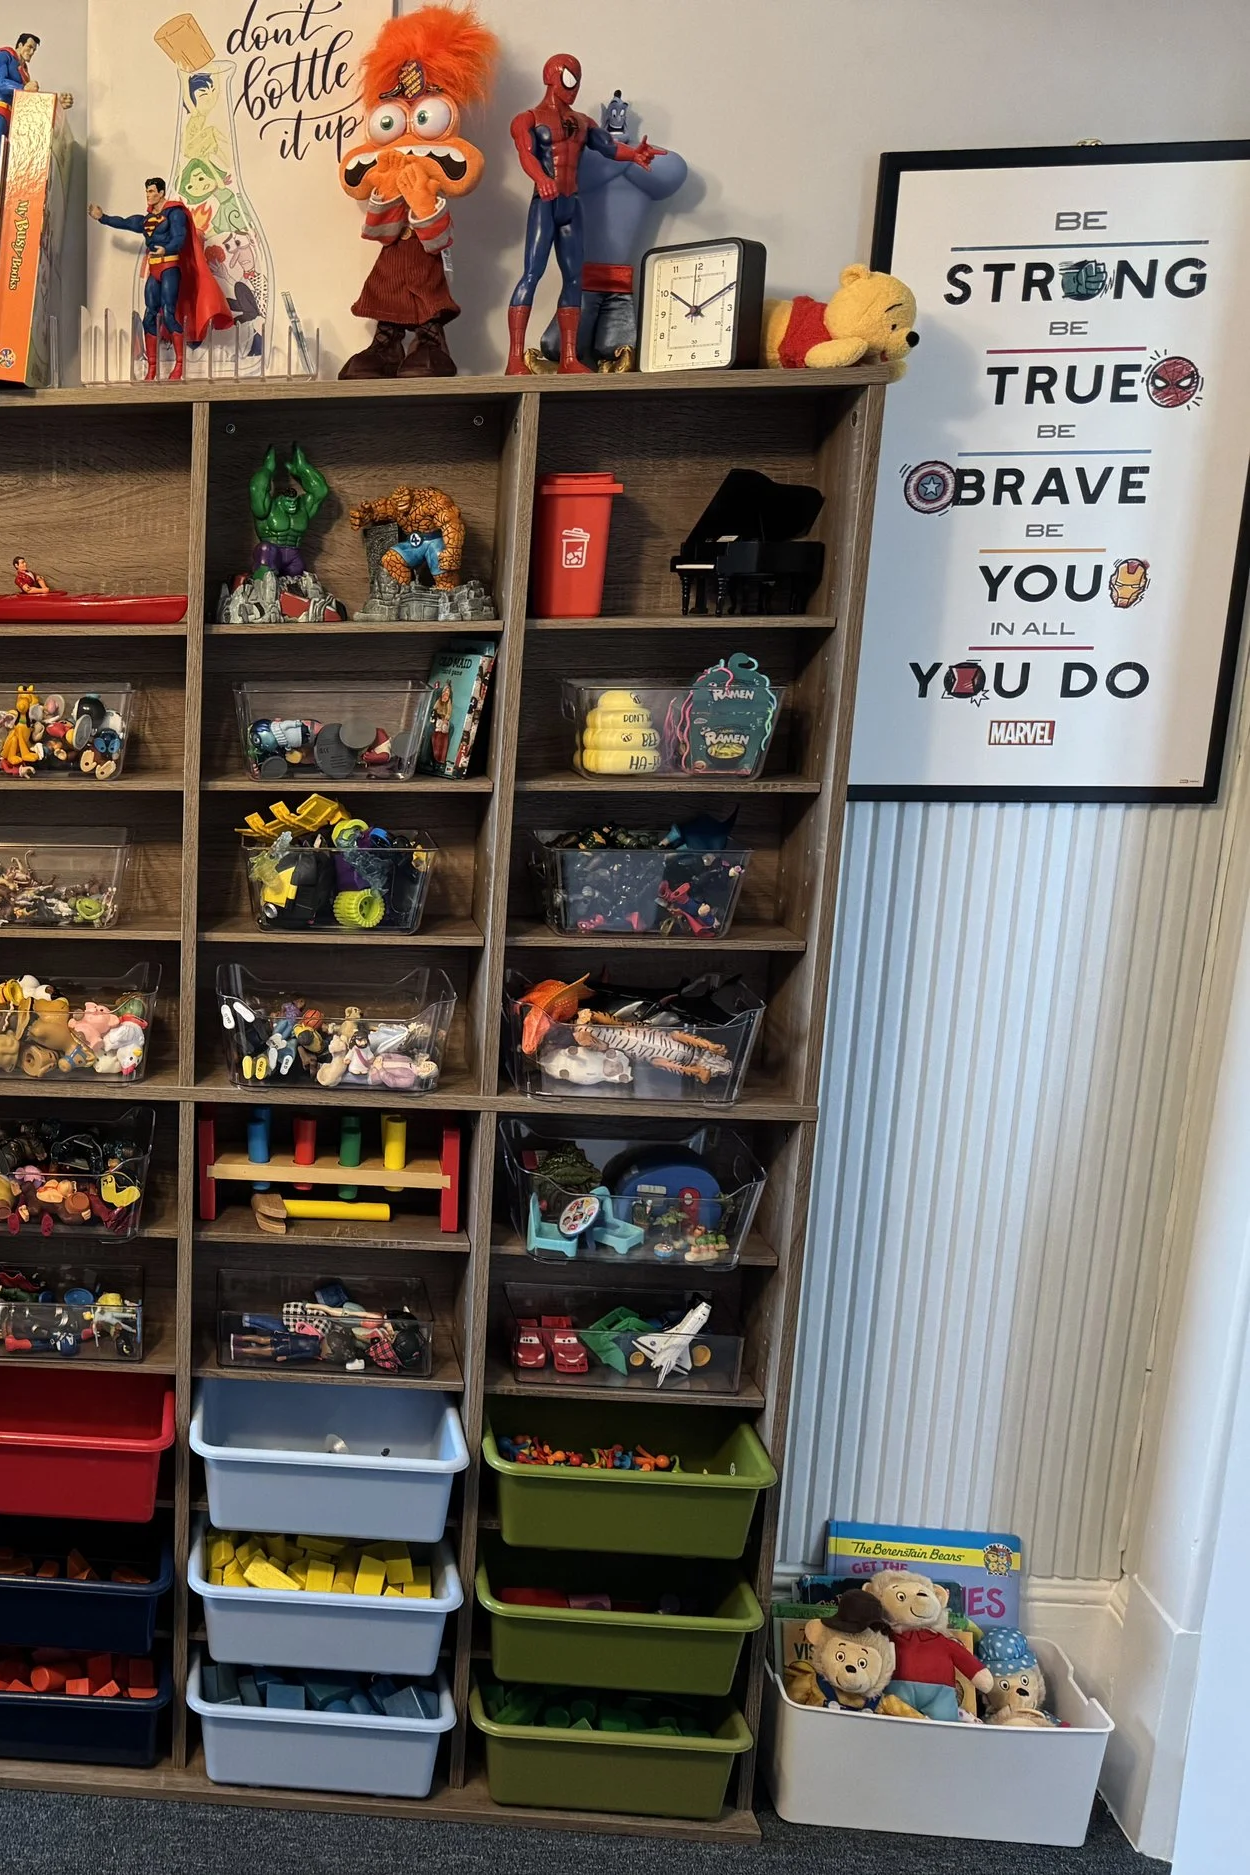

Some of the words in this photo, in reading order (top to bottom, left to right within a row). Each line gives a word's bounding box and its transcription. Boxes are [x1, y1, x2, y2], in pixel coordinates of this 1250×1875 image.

[233, 30, 355, 120] bottle
[314, 114, 364, 163] up
[15, 199, 29, 219] My
[1054, 210, 1108, 231] BE
[10, 218, 30, 258] Busy
[9, 256, 22, 290] Books
[673, 265, 679, 273] 11
[661, 289, 669, 298] 10
[727, 304, 733, 312] 3
[1048, 320, 1089, 336] BE
[659, 332, 665, 340] 8
[690, 352, 696, 360] 6
[714, 349, 720, 358] 5
[986, 364, 1143, 405] TRUE
[1037, 424, 1077, 440] BE
[954, 466, 1151, 507] BRAVE
[1025, 523, 1064, 538] BE
[410, 534, 420, 545] 4
[978, 564, 1103, 604] YOU
[990, 622, 1015, 636] IN
[1022, 622, 1075, 636] ALL
[452, 657, 473, 669] MAID
[909, 661, 1031, 699] YOU
[1060, 661, 1150, 699] DO
[712, 689, 755, 701] RAMEN
[623, 714, 645, 723] DON'T
[704, 731, 750, 745] RAMEN
[989, 720, 1054, 745] MARVEL
[851, 1541, 872, 1555] The
[872, 1543, 928, 1560] Berenstain
[929, 1551, 963, 1562] Bears
[852, 1561, 877, 1574] GET
[882, 1561, 909, 1571] THE
